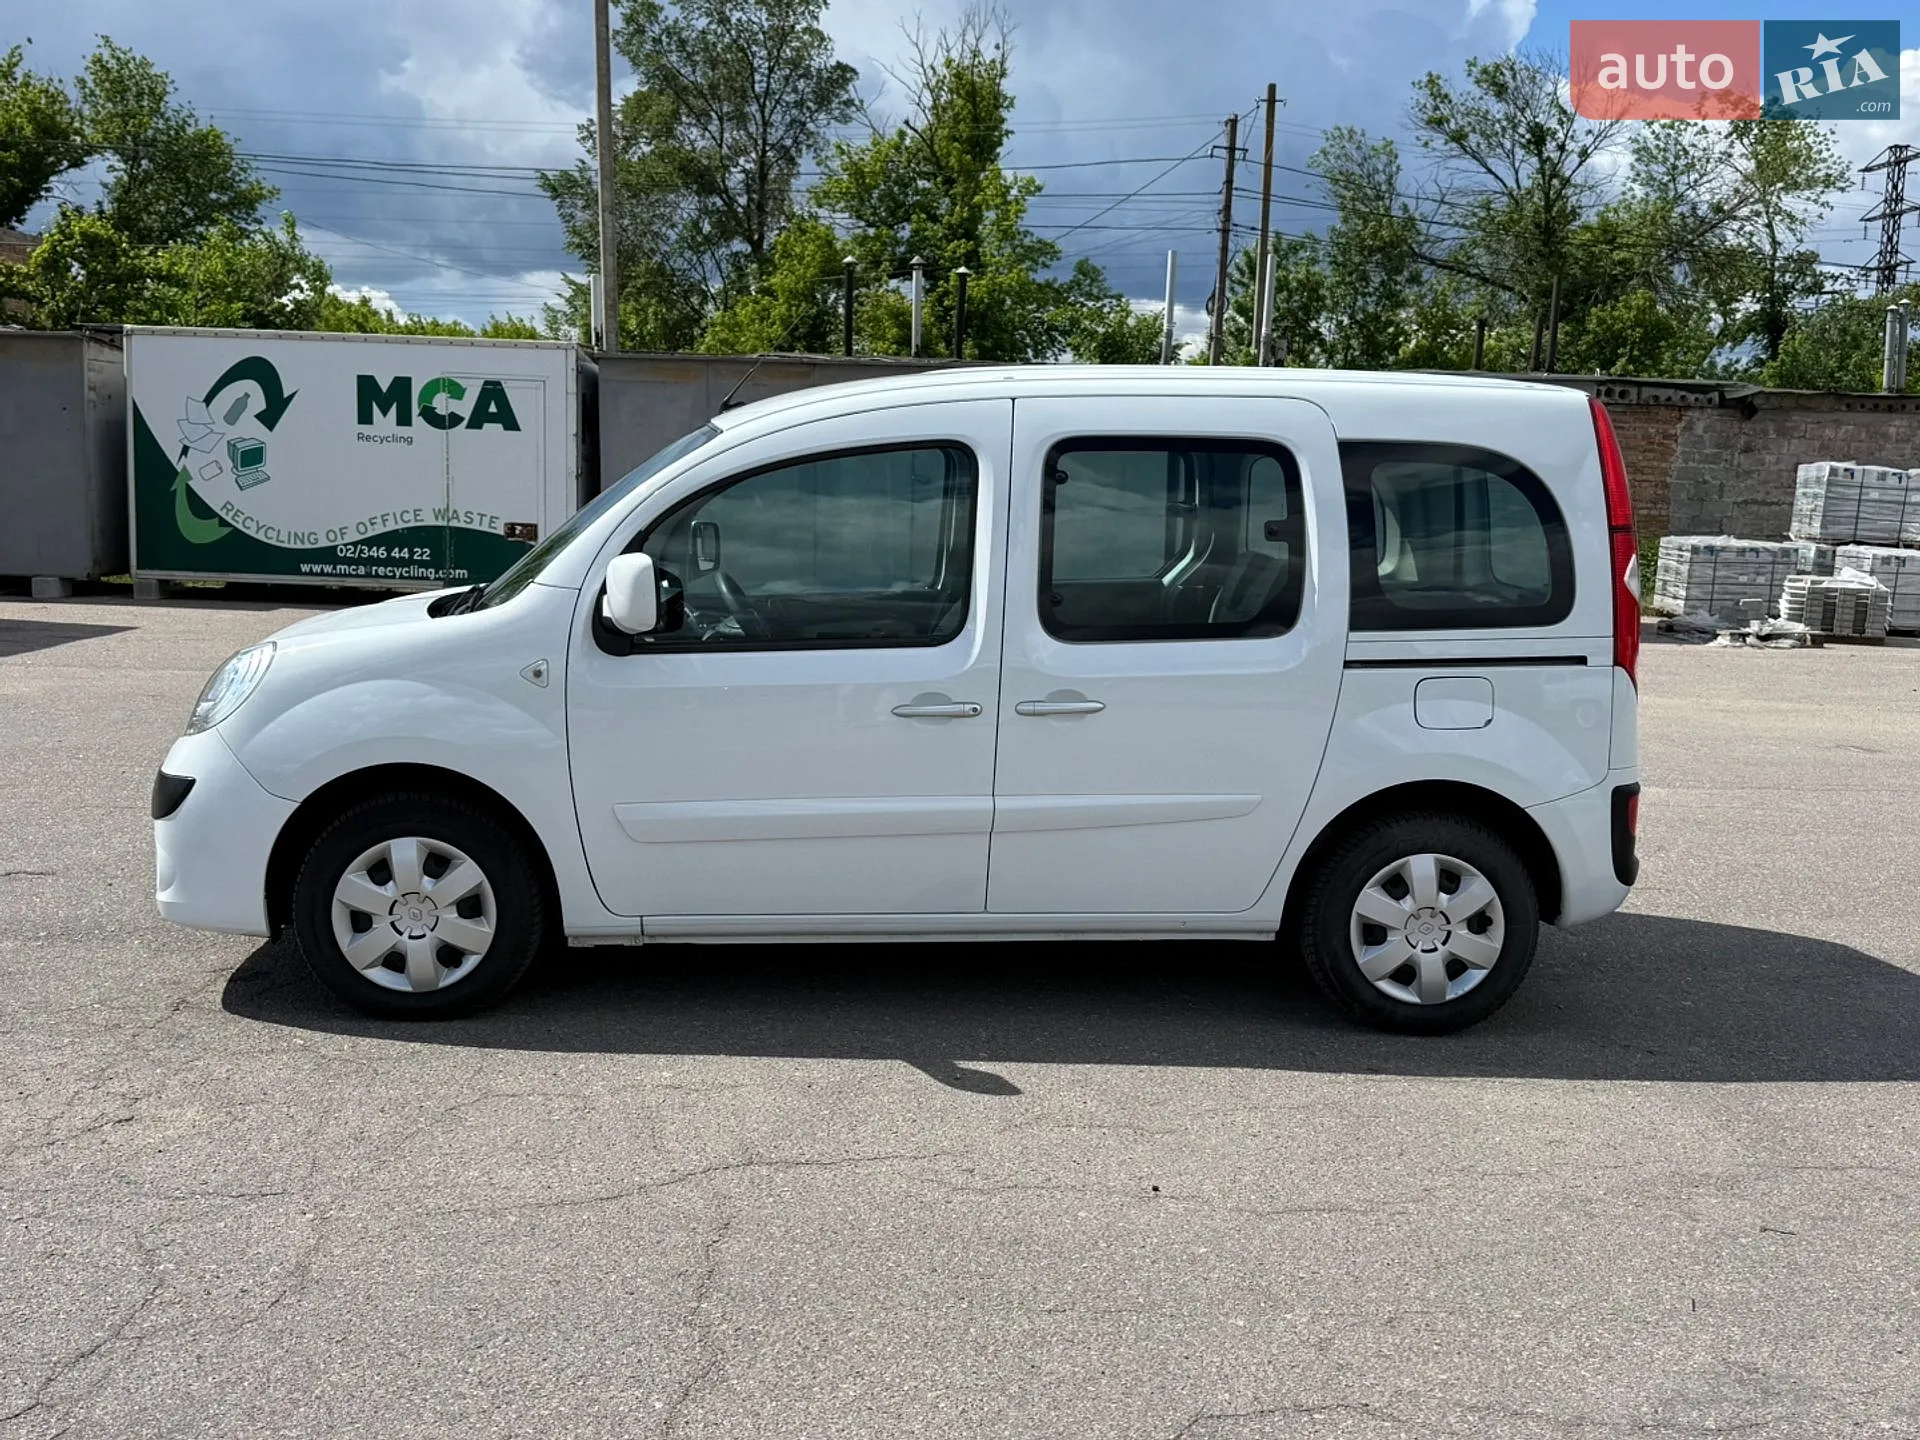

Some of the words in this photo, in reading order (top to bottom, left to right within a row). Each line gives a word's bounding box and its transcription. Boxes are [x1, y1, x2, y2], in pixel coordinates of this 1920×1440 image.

[356, 374, 522, 432] MCA
[357, 432, 414, 446] Recycling
[219, 500, 320, 546] RECYCLING
[325, 526, 350, 544] OF
[356, 507, 425, 536] OFFICE
[432, 507, 500, 530] WASTE
[336, 545, 388, 560] 02/346
[390, 547, 410, 560] 44
[413, 548, 431, 561] 22
